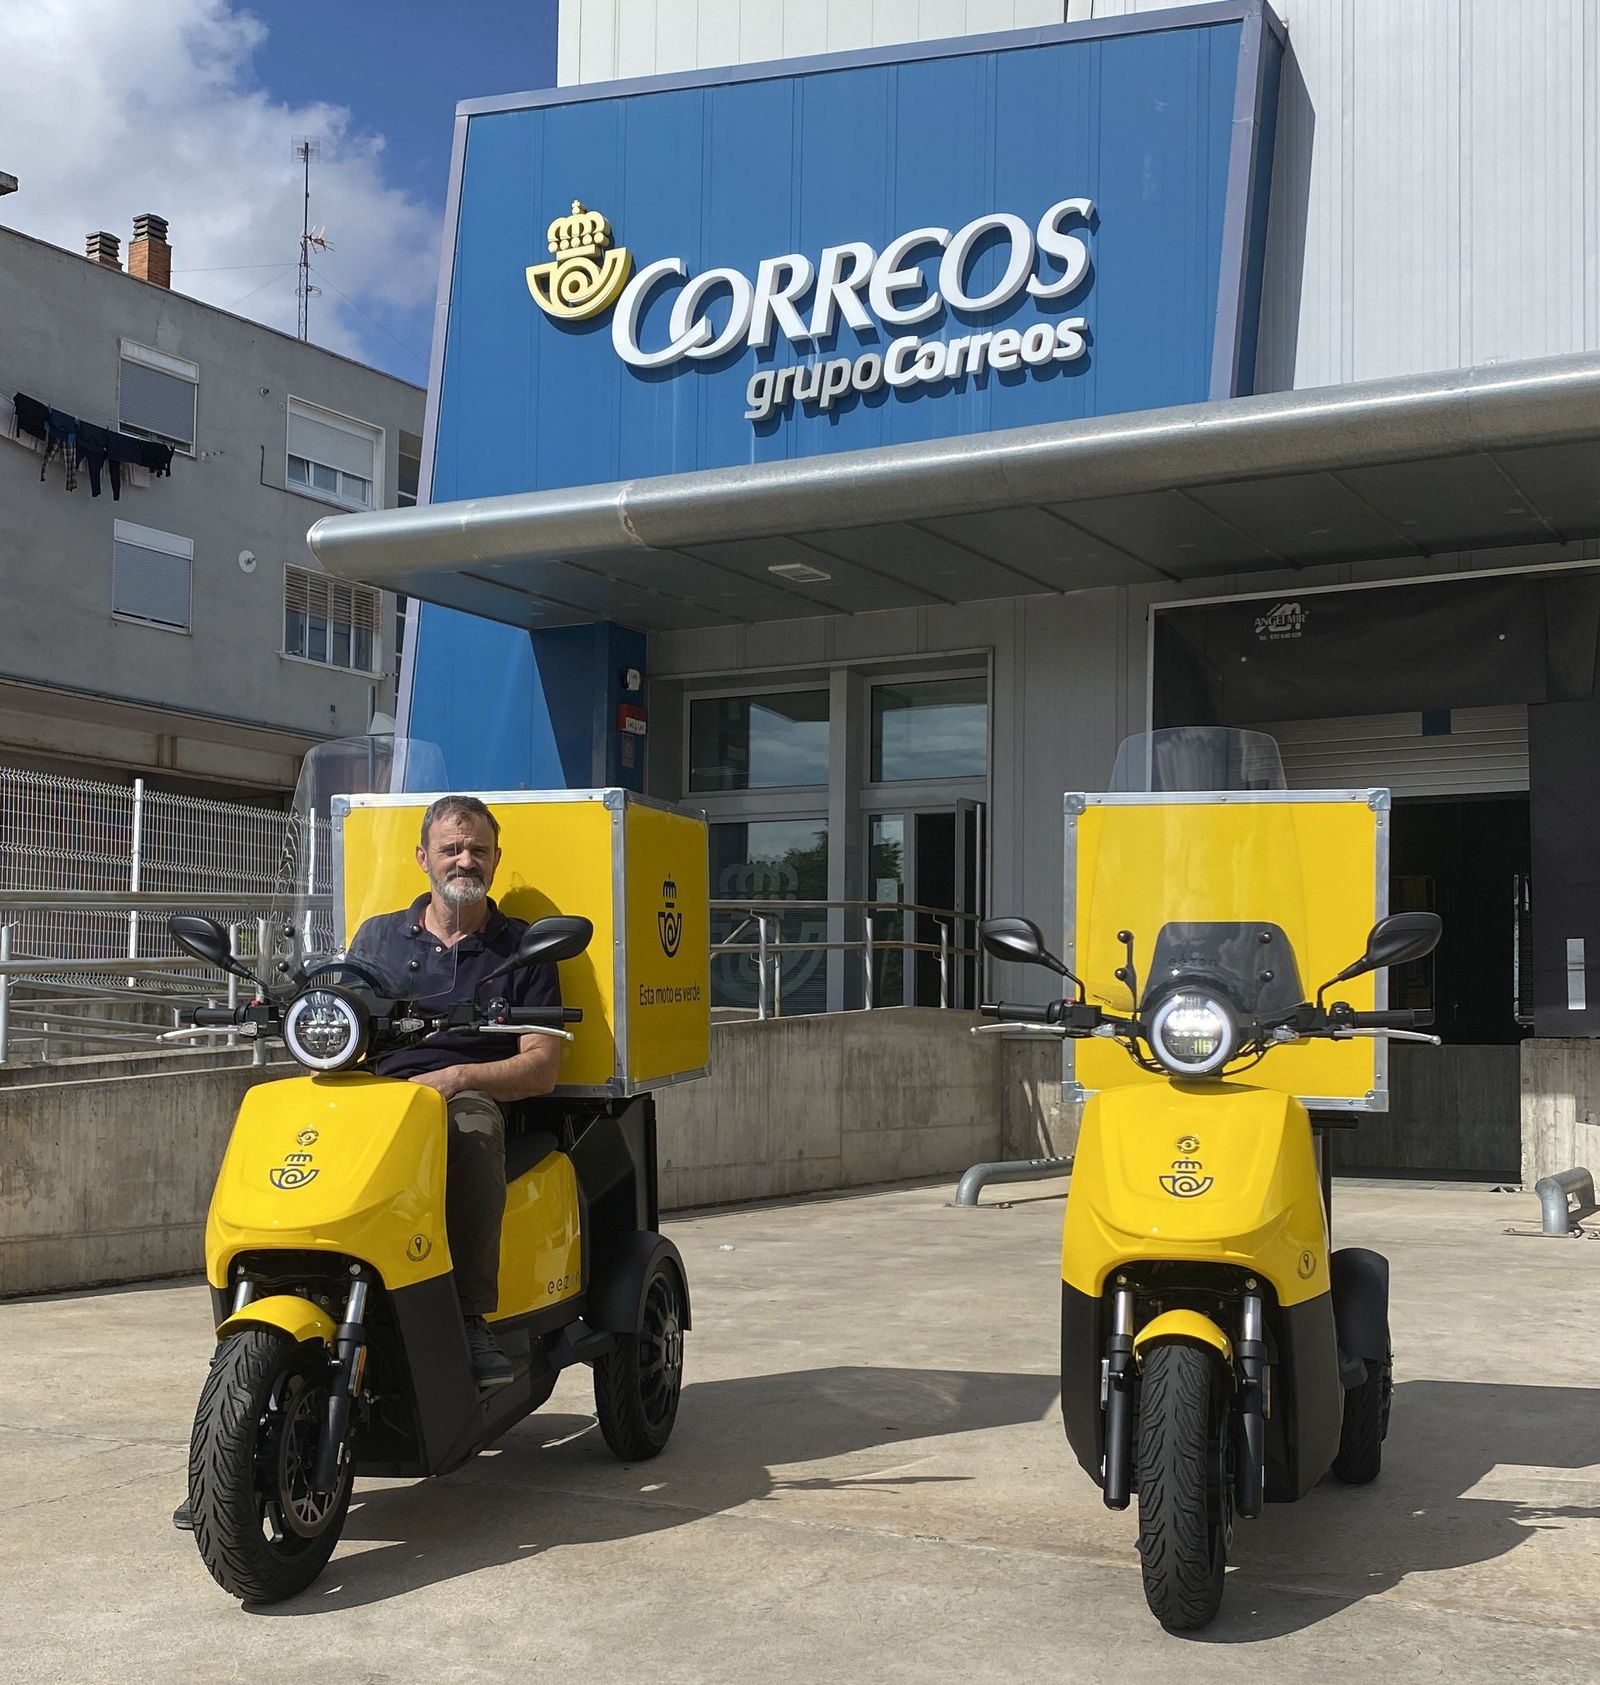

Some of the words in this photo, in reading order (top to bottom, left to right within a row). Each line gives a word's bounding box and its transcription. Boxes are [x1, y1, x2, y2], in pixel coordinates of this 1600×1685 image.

[610, 197, 1095, 369] CORREOS
[639, 984, 655, 1006] Esta
[655, 984, 674, 1004] moto
[674, 986, 683, 1002] es
[683, 980, 701, 1002] verde
